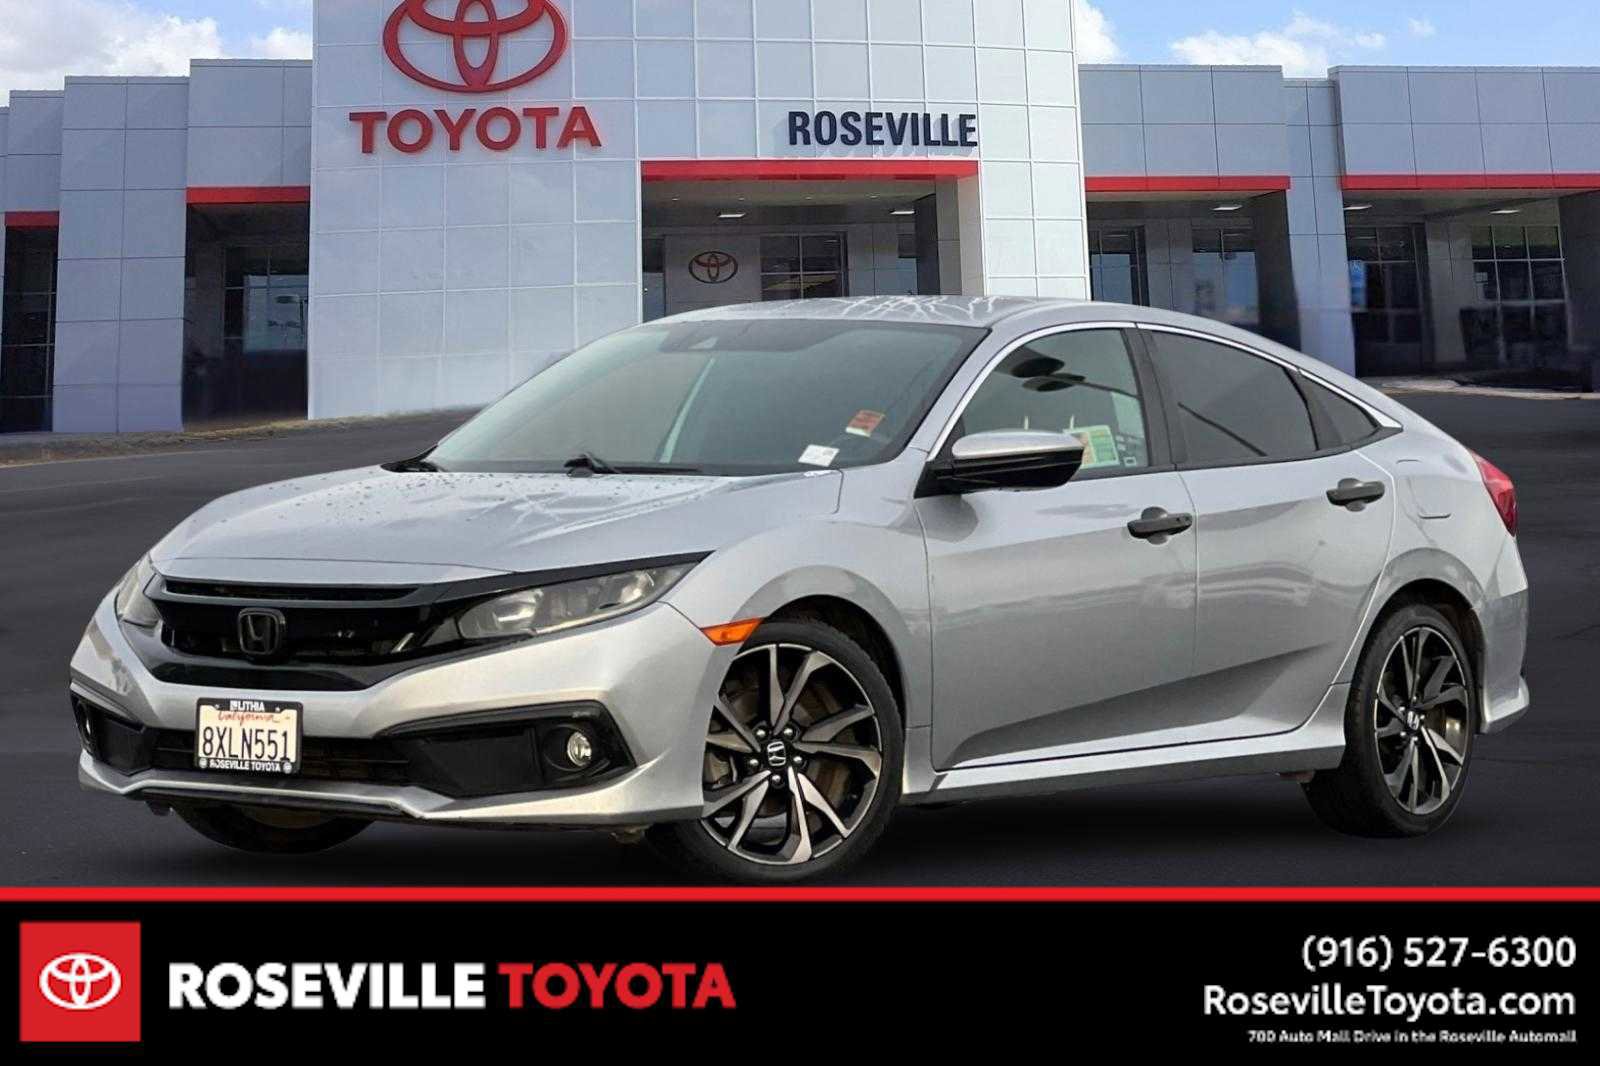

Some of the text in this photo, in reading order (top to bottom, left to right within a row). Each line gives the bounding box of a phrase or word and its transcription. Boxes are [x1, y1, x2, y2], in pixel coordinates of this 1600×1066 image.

[349, 106, 602, 153] TOYOTA
[788, 111, 978, 147] ROSEVILLE
[238, 700, 265, 712] LITHIA
[203, 726, 290, 761] 8XLN551
[209, 760, 281, 771] ROSEVILLE TOYOTA
